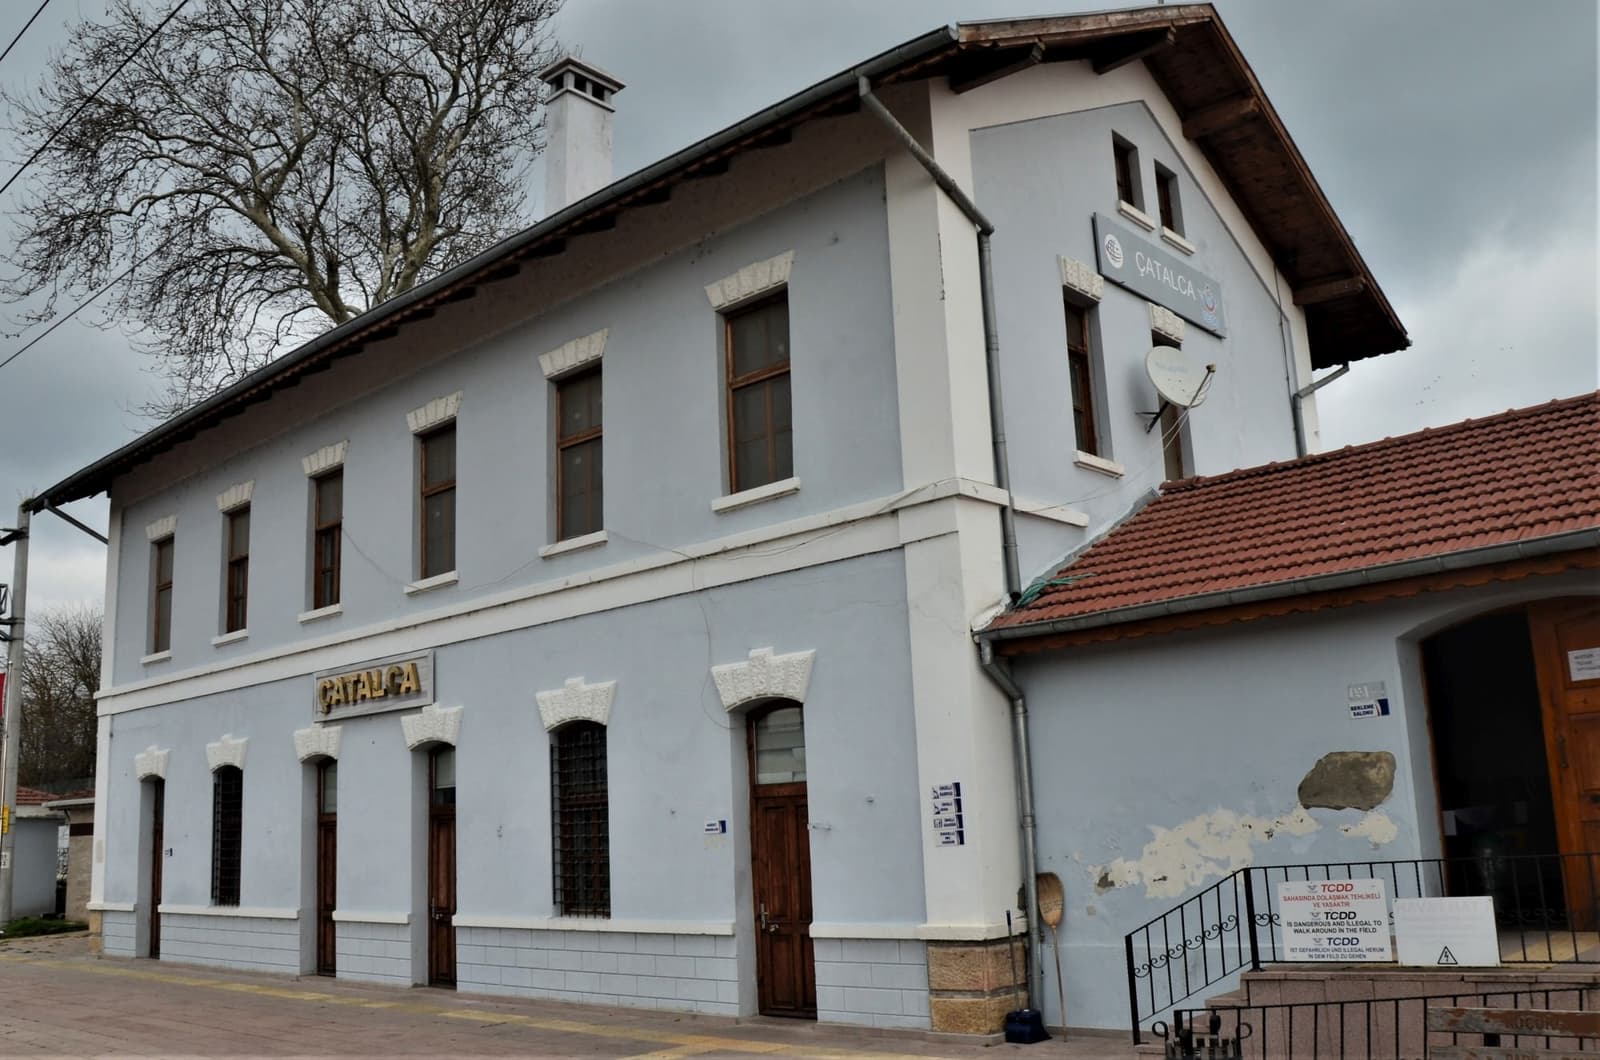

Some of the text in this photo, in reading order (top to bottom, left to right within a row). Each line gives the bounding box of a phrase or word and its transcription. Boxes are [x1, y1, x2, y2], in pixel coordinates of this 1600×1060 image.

[1136, 251, 1197, 300] ÇATALCA
[319, 662, 421, 714] ÇATALCA
[1321, 883, 1354, 893] TCDD
[1324, 911, 1357, 920] TCDD
[1327, 937, 1360, 946] TCDD
